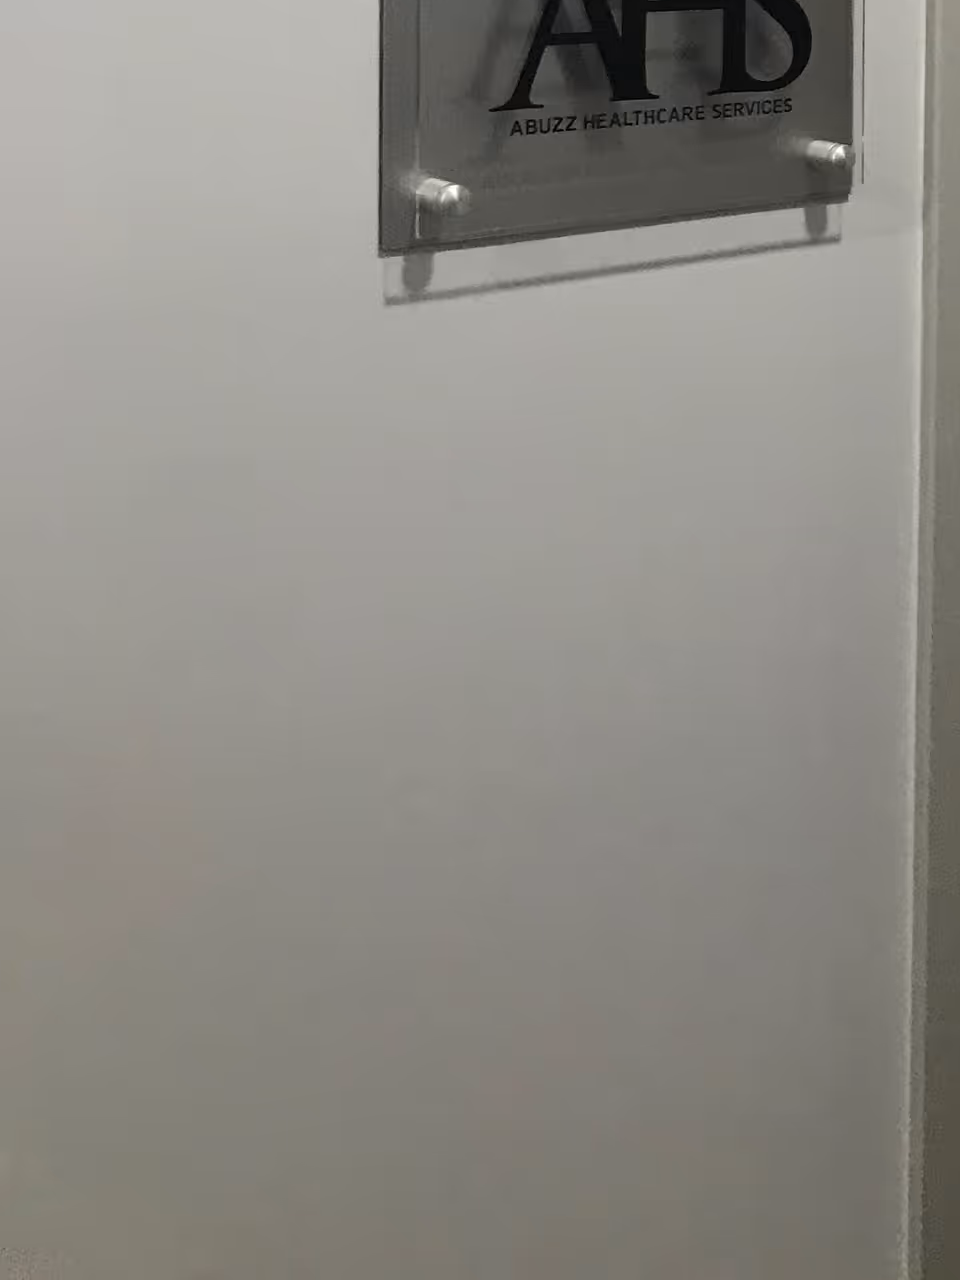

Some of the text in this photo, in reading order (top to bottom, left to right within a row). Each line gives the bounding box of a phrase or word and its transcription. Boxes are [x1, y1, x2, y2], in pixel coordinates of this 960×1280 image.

[510, 98, 792, 136] ABUZZ HEALTHCARE SERVICES
